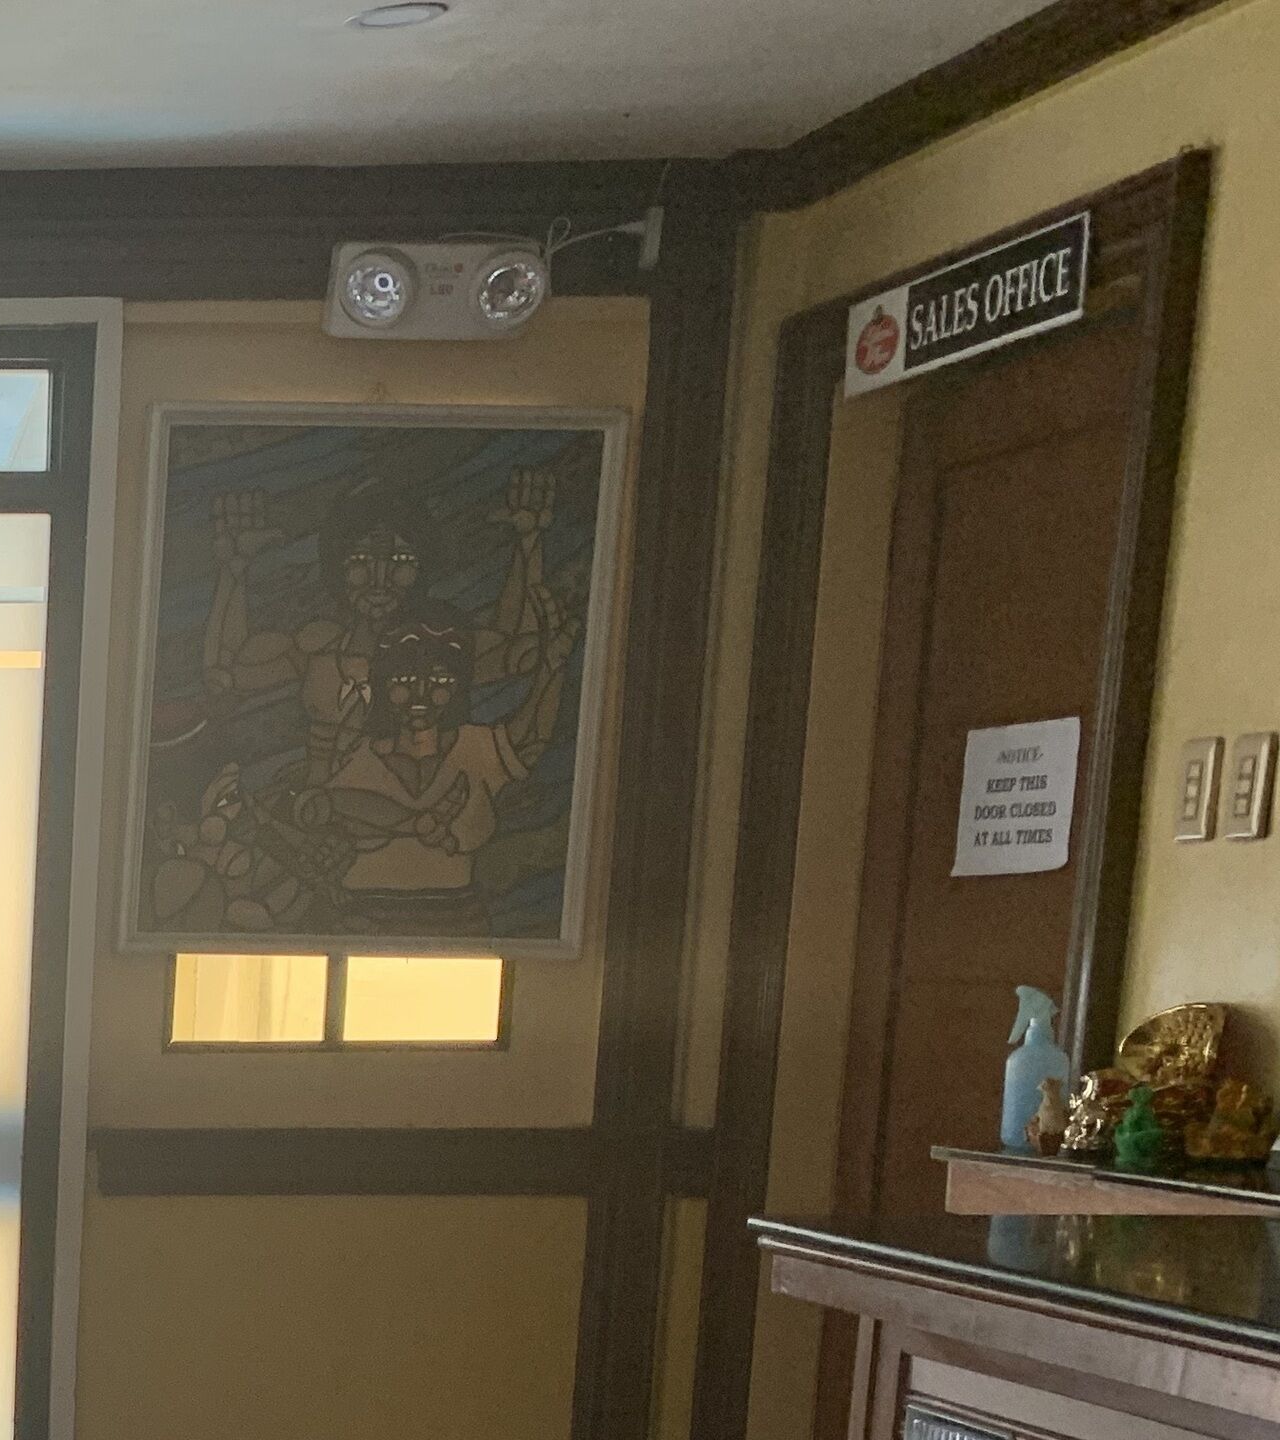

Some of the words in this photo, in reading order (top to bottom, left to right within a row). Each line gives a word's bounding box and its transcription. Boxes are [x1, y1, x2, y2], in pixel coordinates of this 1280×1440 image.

[909, 282, 981, 351] SALES
[984, 247, 1072, 322] OFFICE
[986, 777, 1017, 793] KEEP
[1019, 775, 1048, 792] THIS
[974, 804, 1007, 820] DOOR
[1009, 801, 1057, 817] CLOSED
[974, 832, 989, 847] AT
[991, 830, 1012, 846] ALL
[1016, 828, 1053, 844] TIMES
